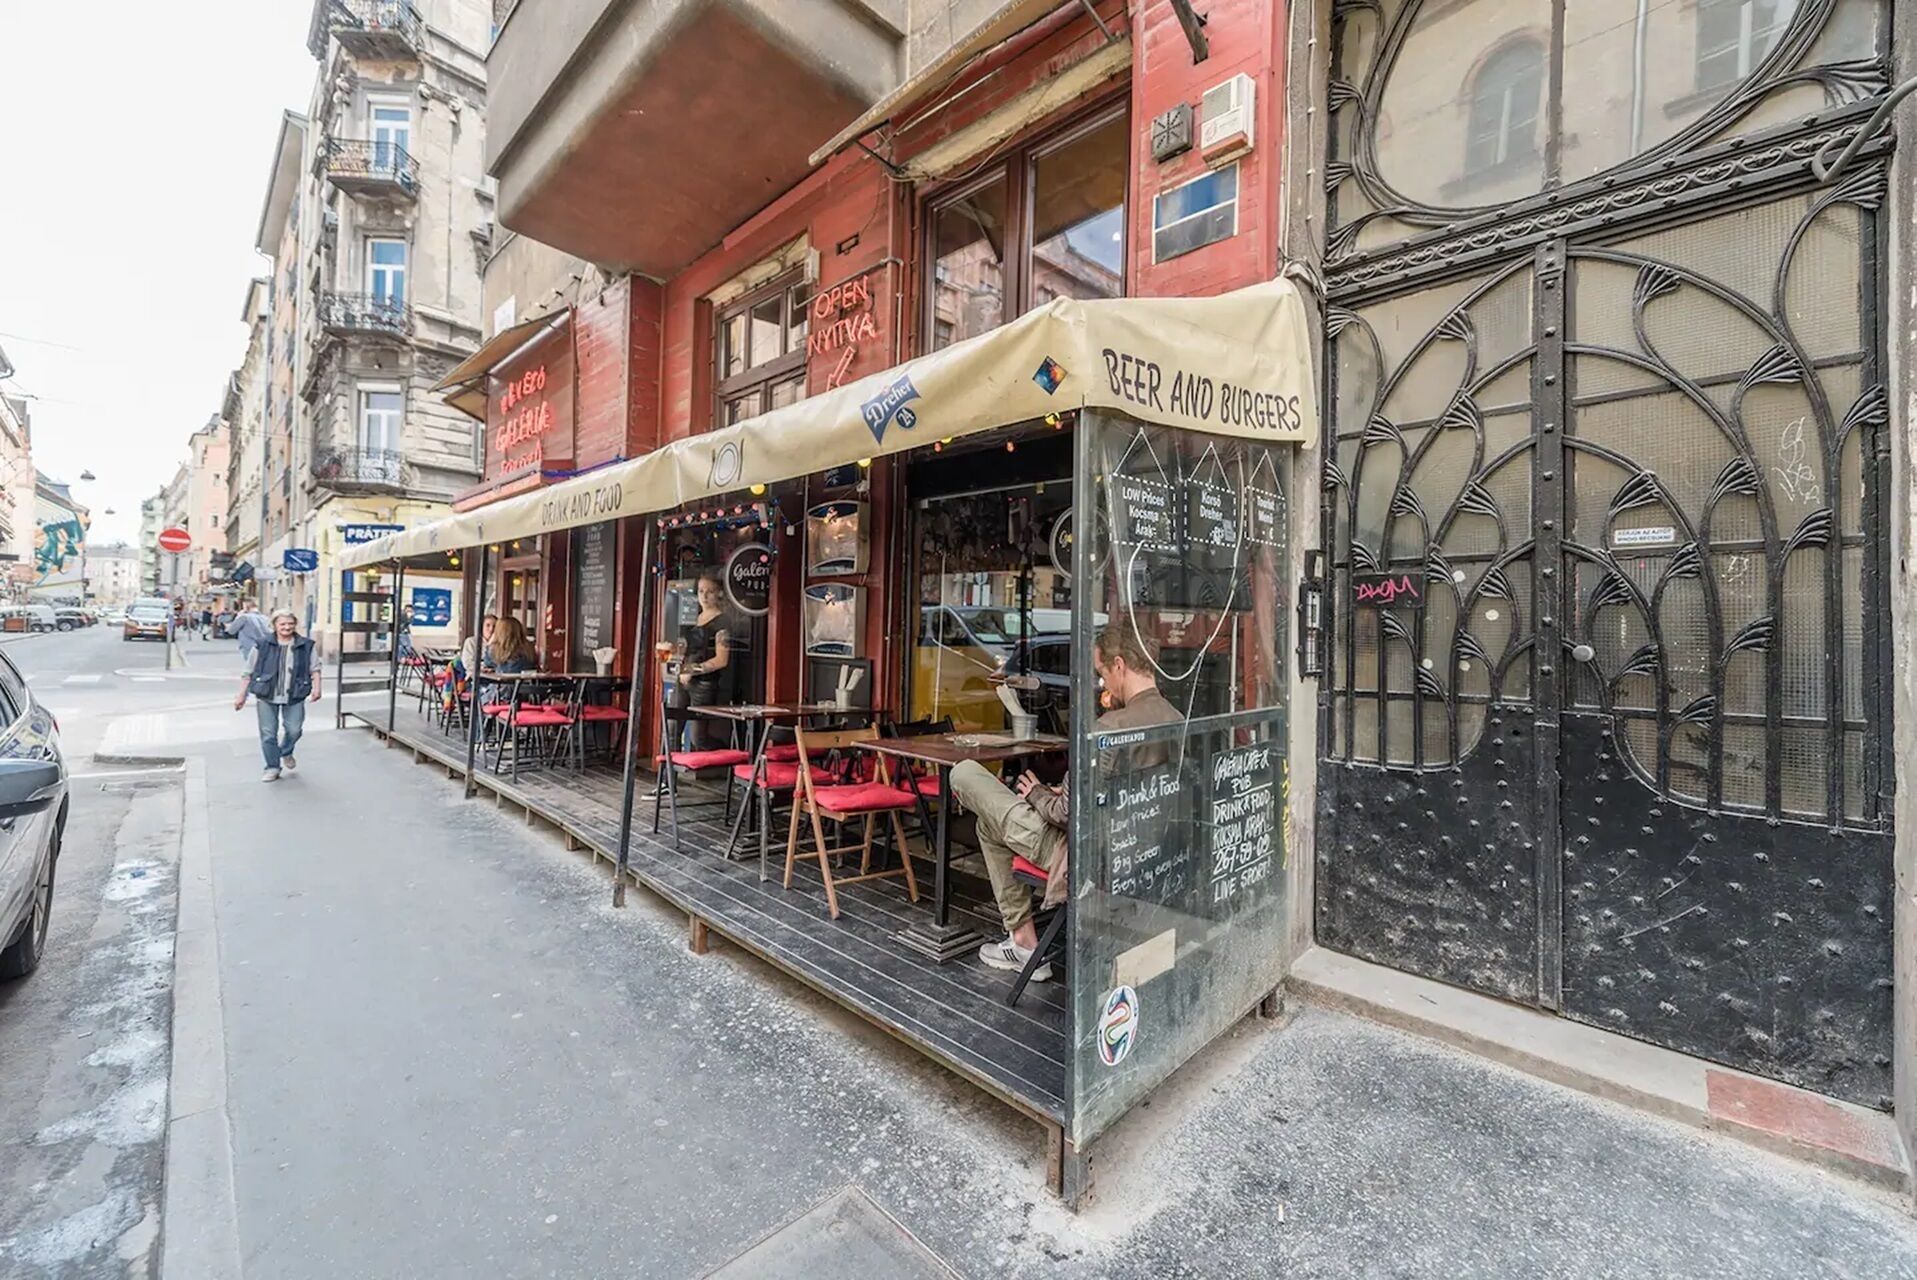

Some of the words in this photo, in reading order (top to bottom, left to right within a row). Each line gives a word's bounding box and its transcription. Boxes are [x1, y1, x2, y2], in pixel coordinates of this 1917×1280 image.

[815, 275, 869, 319] OPEN
[807, 312, 877, 357] NYITVA
[1102, 348, 1164, 413] BEER
[1170, 370, 1214, 420] AND
[1220, 383, 1301, 432] BURGERS
[866, 381, 912, 428] Dreher
[897, 411, 914, 427] 24
[542, 500, 569, 527] DRINK
[570, 491, 591, 521] AND
[594, 482, 623, 516] FOOD
[1122, 486, 1141, 502] LOW
[346, 525, 398, 540] PRÁTE
[1116, 780, 1149, 811] Drink
[1158, 773, 1180, 797] Food
[1230, 774, 1253, 794] PUB
[1213, 797, 1245, 826] DRINK
[1112, 854, 1132, 874] Big
[1111, 877, 1137, 896] Every
[1213, 876, 1238, 904] LIVE
